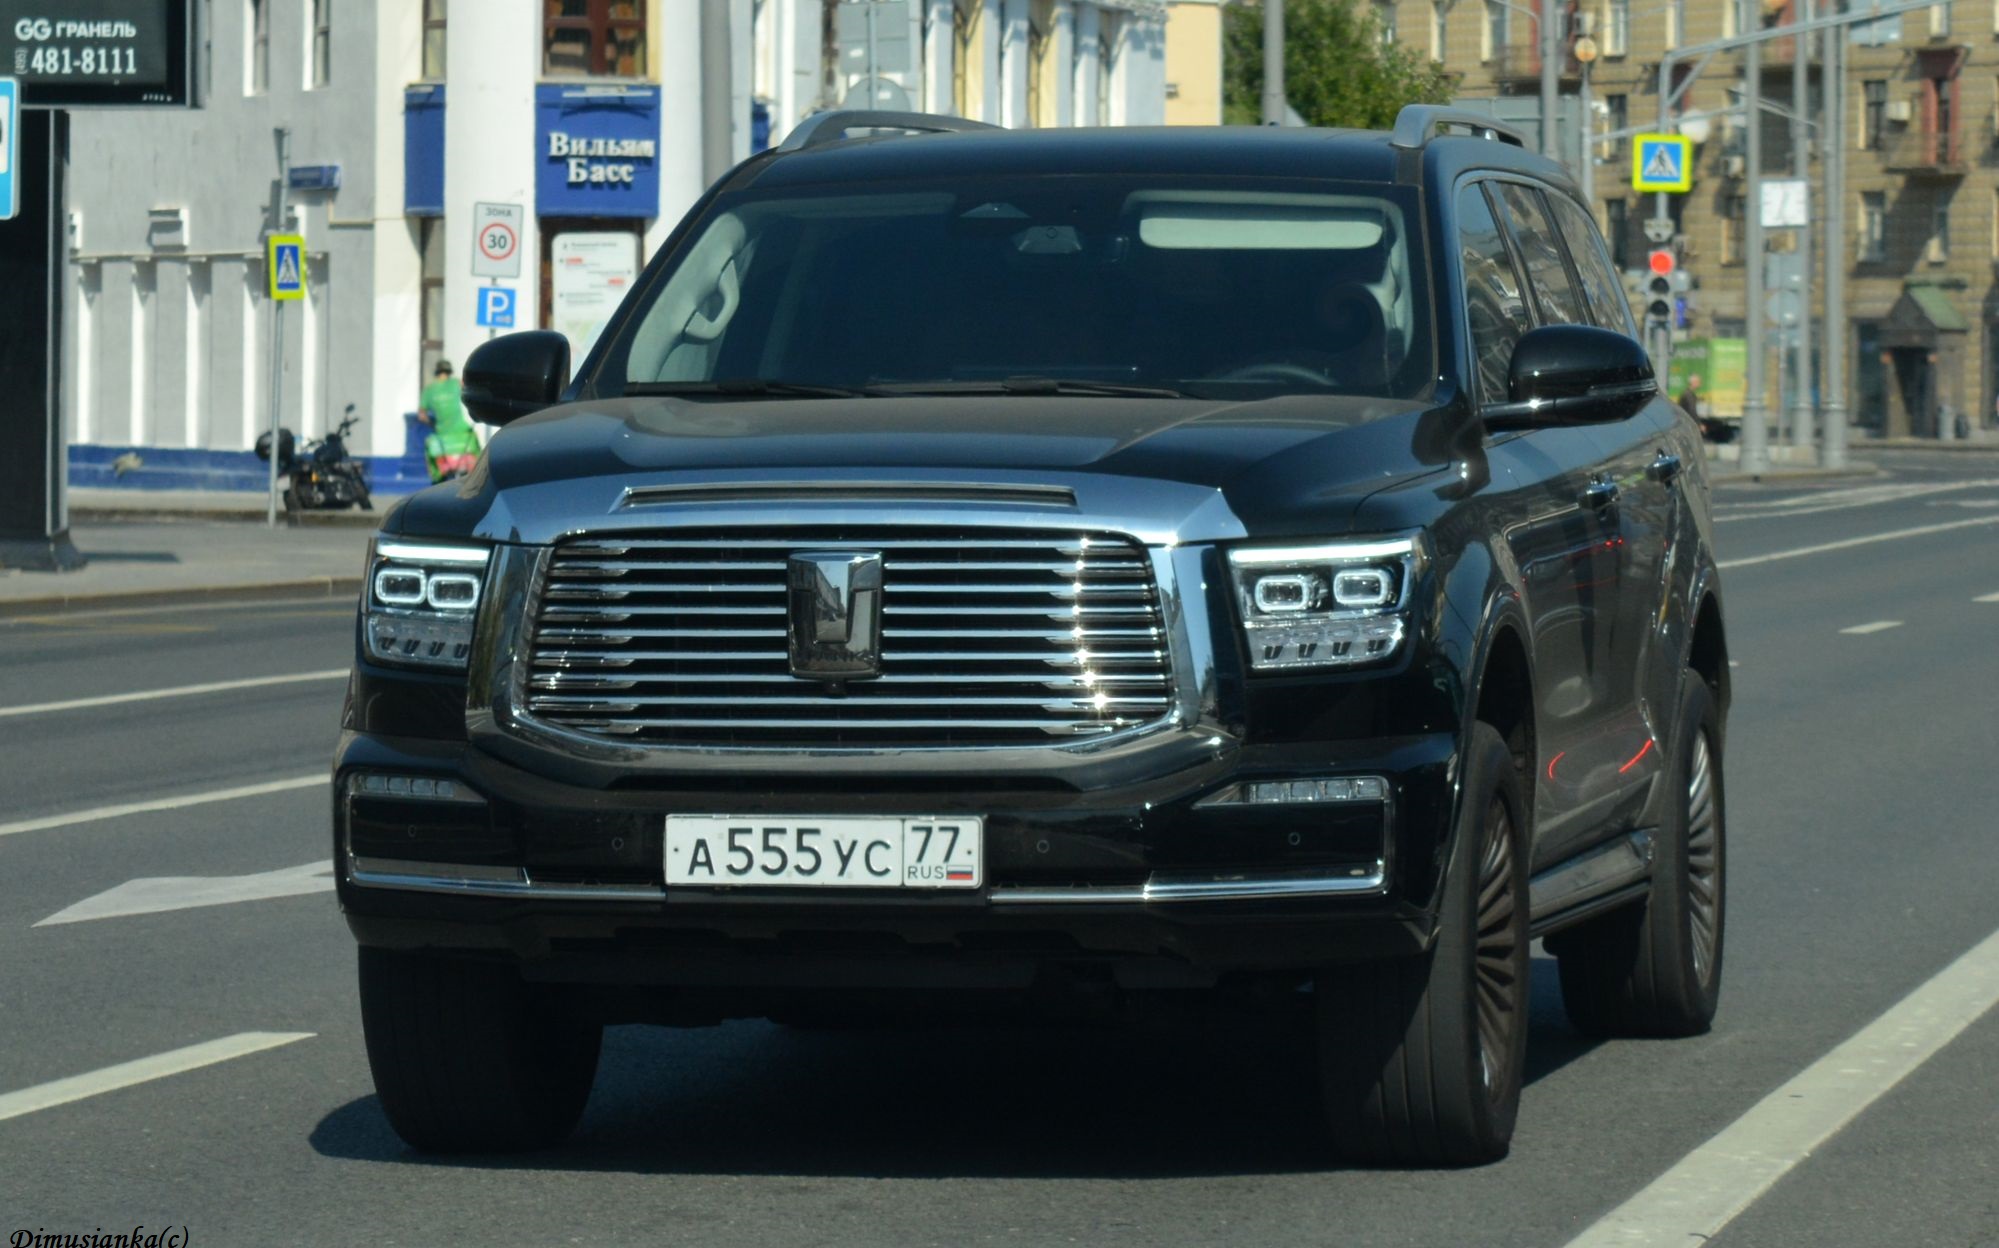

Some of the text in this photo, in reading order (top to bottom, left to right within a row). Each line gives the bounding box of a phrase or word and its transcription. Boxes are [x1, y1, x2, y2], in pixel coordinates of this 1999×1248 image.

[56, 21, 137, 38] ГРАНЕЛЬ
[31, 48, 137, 74] 481-8111
[549, 132, 655, 158] Вильям
[567, 158, 634, 182] Басс
[485, 207, 512, 217] ЗОНА
[487, 234, 507, 249] 30
[911, 826, 960, 863] 77
[907, 866, 944, 880] RUS
